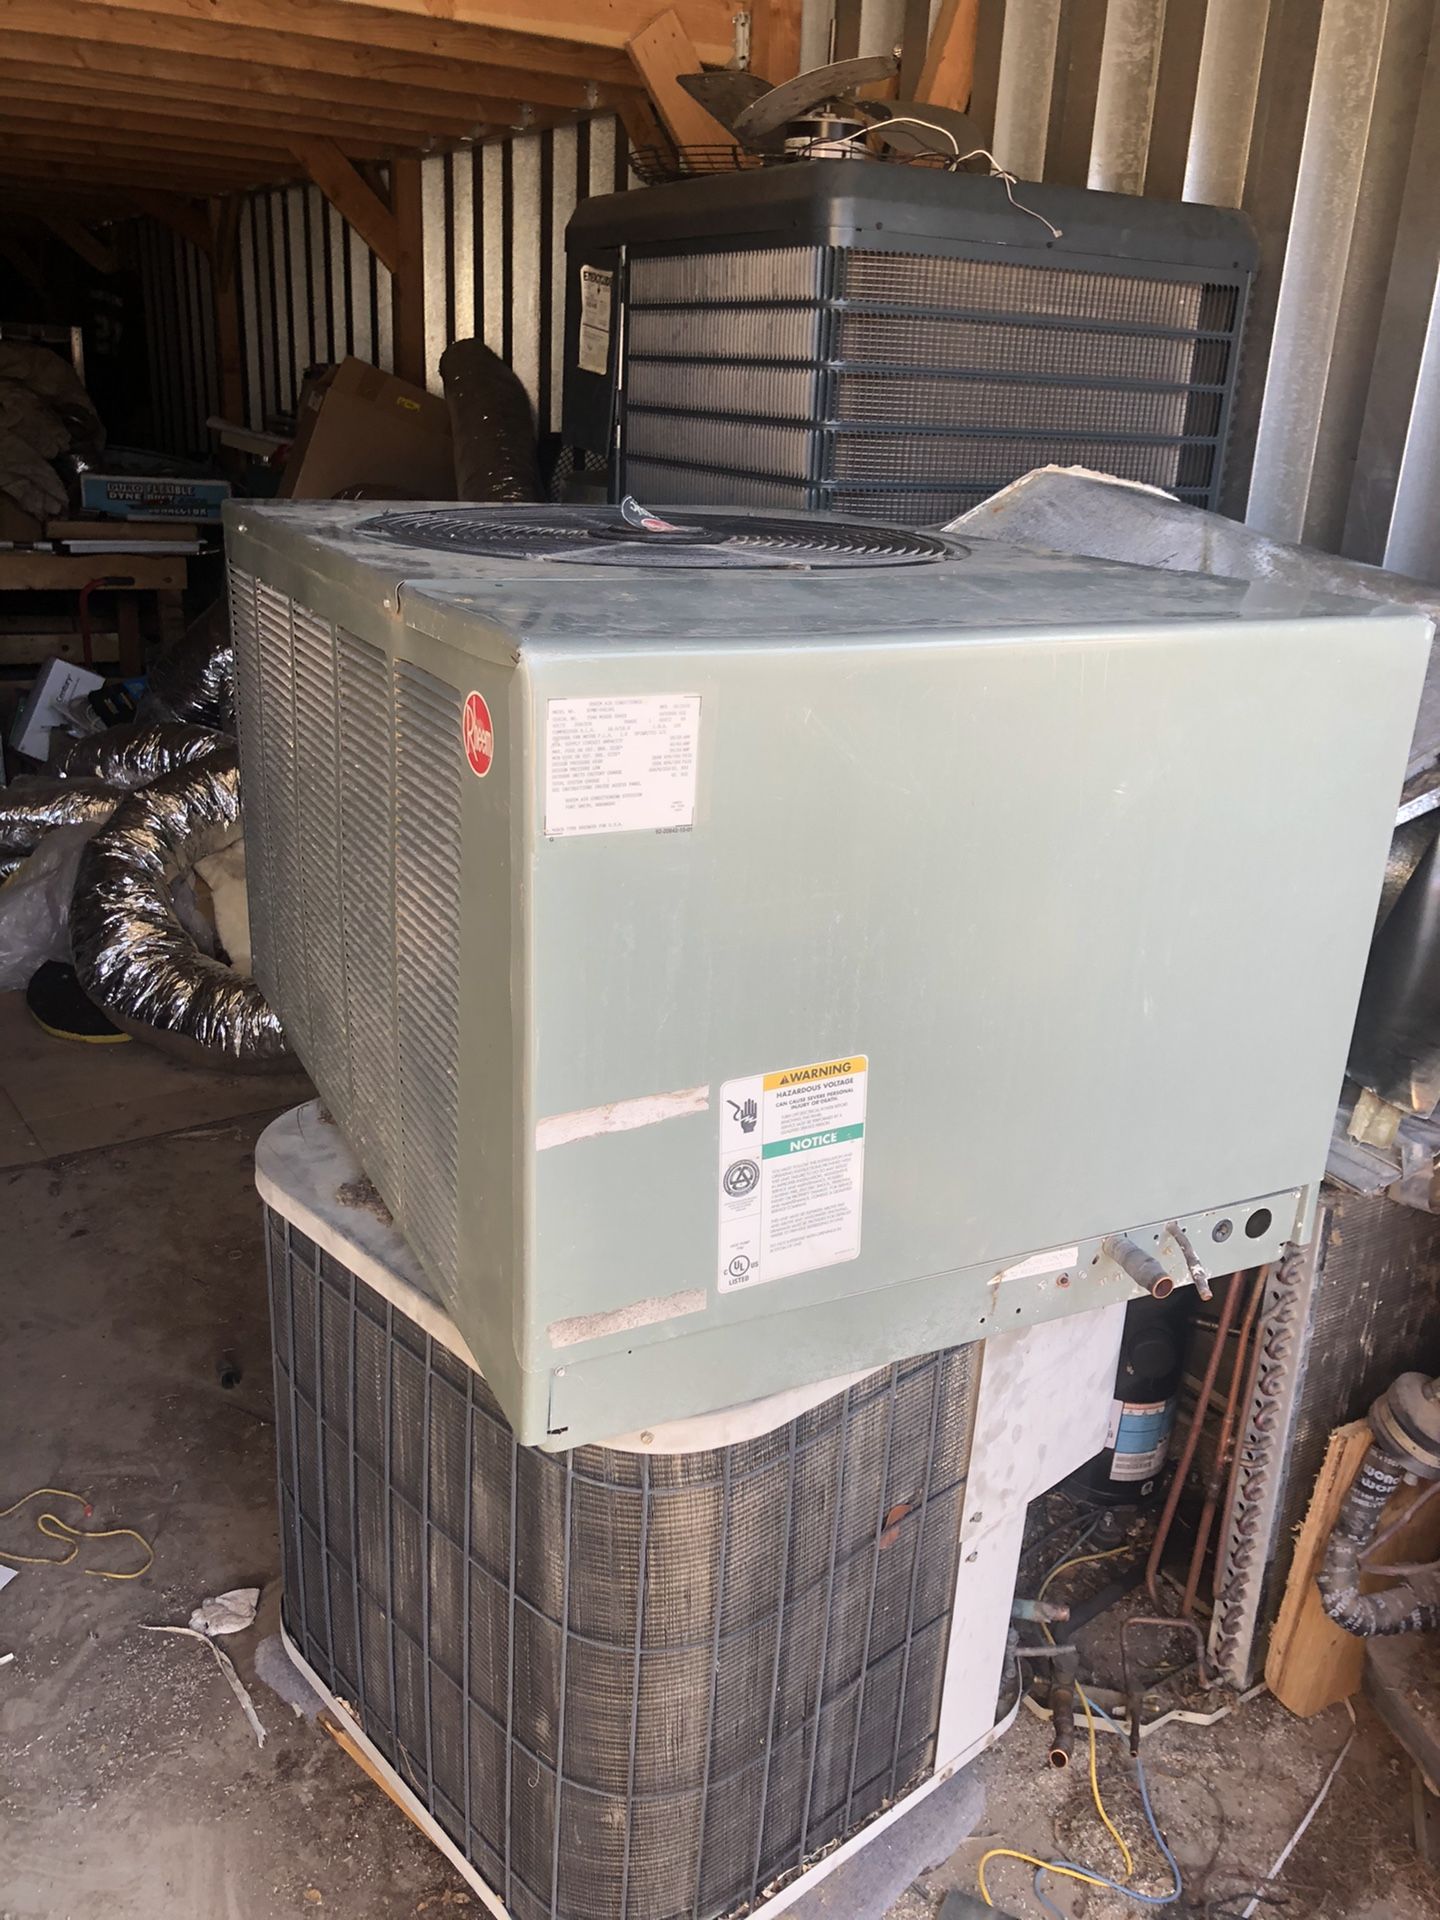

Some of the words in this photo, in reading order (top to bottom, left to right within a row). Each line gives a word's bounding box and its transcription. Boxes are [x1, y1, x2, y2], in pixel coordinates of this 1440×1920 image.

[108, 491, 142, 501] DYNE
[146, 483, 195, 496] FLEXIBLE
[466, 695, 492, 762] Rheem
[790, 1062, 852, 1083] WARNING
[776, 1084, 821, 1099] HAZARDOUS
[824, 1077, 854, 1089] VOLTAGE
[776, 1100, 788, 1108] CAN
[789, 1097, 806, 1106] CAUSE
[807, 1093, 826, 1102] SEVERE
[827, 1088, 854, 1098] PERSONAL
[791, 1102, 810, 1110] INJURY
[790, 1132, 838, 1152] NOTICE
[728, 1275, 750, 1286] LISTED
